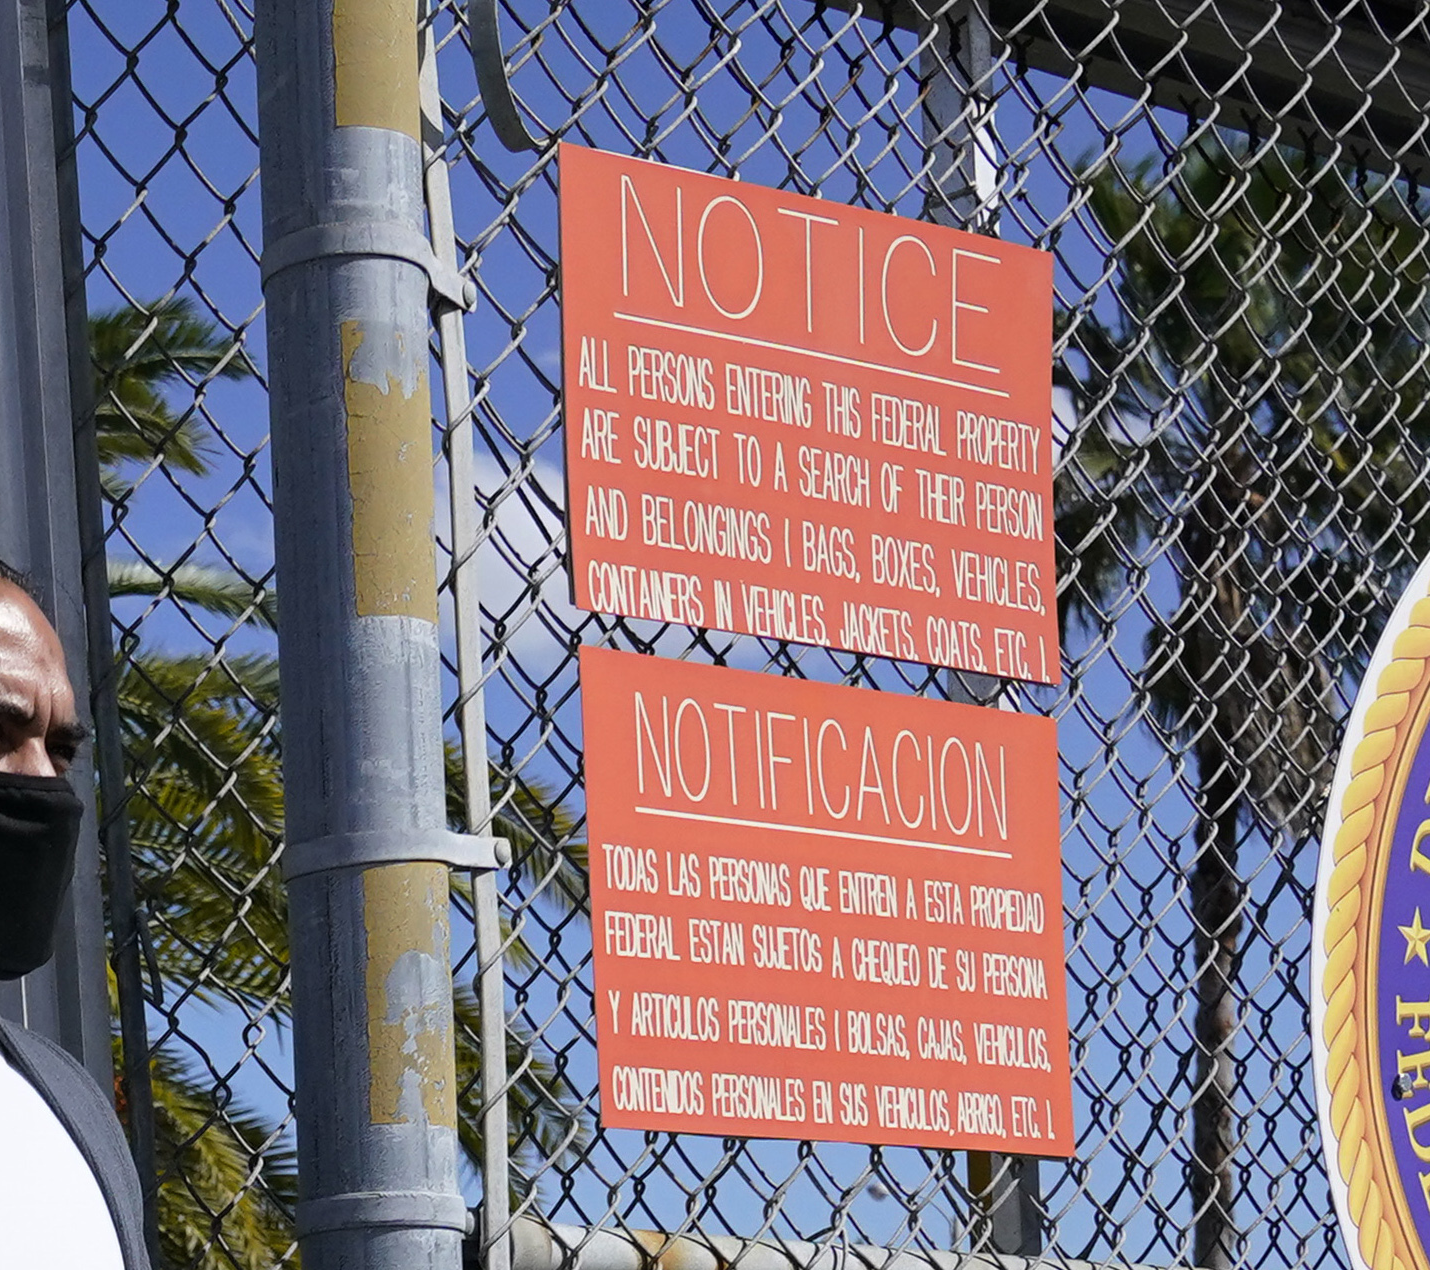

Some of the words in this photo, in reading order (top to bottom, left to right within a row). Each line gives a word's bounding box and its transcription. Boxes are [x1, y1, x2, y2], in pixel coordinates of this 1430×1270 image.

[620, 174, 1001, 374] NOTICE
[578, 335, 618, 394] ALL
[627, 345, 716, 411] PERSONS
[725, 362, 812, 429] ENTERING
[821, 381, 862, 439] THIS
[871, 392, 947, 457] FEDERAL
[956, 410, 1041, 475] PROPERTY
[581, 407, 622, 464] ARE
[633, 415, 721, 480] SUBJECT
[732, 432, 762, 488] TO
[773, 441, 788, 493] A
[798, 445, 871, 509] SEARCH
[880, 461, 904, 514] OF
[914, 468, 966, 527] THEIR
[975, 481, 1044, 542] PERSON
[585, 484, 629, 541] AND
[641, 493, 773, 565] BELONGINGS
[802, 520, 861, 584] BAGS,
[871, 533, 941, 598] BOXES,
[950, 548, 1046, 617] VEHICLES,
[587, 559, 705, 627] CONTAINERS
[713, 579, 734, 631] IN
[993, 627, 1033, 681] ETC.
[634, 691, 1008, 841] NOTIFICACION
[601, 843, 659, 894] TODAS
[666, 850, 702, 898] LAS
[708, 855, 792, 908] PERSONAS
[799, 865, 832, 912] QUE
[838, 870, 898, 918] ENTREN
[905, 878, 918, 921] A
[923, 879, 965, 925] ESTA
[969, 884, 1045, 935] PROPIEDAD
[604, 910, 682, 961] FEDERAL
[688, 918, 745, 967] ESTAN
[751, 923, 823, 973] SUJETOS
[831, 936, 845, 980] A
[851, 937, 921, 987] CHEQUEO
[927, 946, 949, 990] DE
[955, 949, 977, 993] SU
[982, 952, 1049, 1000] PERSONA
[607, 989, 621, 1034] Y
[631, 991, 721, 1043] ARTICULOS
[727, 999, 827, 1051] PERSONALES
[846, 1010, 911, 1061] BOLSAS,
[917, 1016, 968, 1066] CAJAS,
[973, 1022, 1052, 1073] VEHICULOS,
[711, 1072, 806, 1123] PERSONALES
[812, 1080, 834, 1125] EN
[838, 1081, 869, 1127] SUS
[874, 1084, 955, 1137] VEHICULOS,
[957, 1091, 1007, 1139] ABRIGO,
[1010, 1095, 1042, 1139] ETC.
